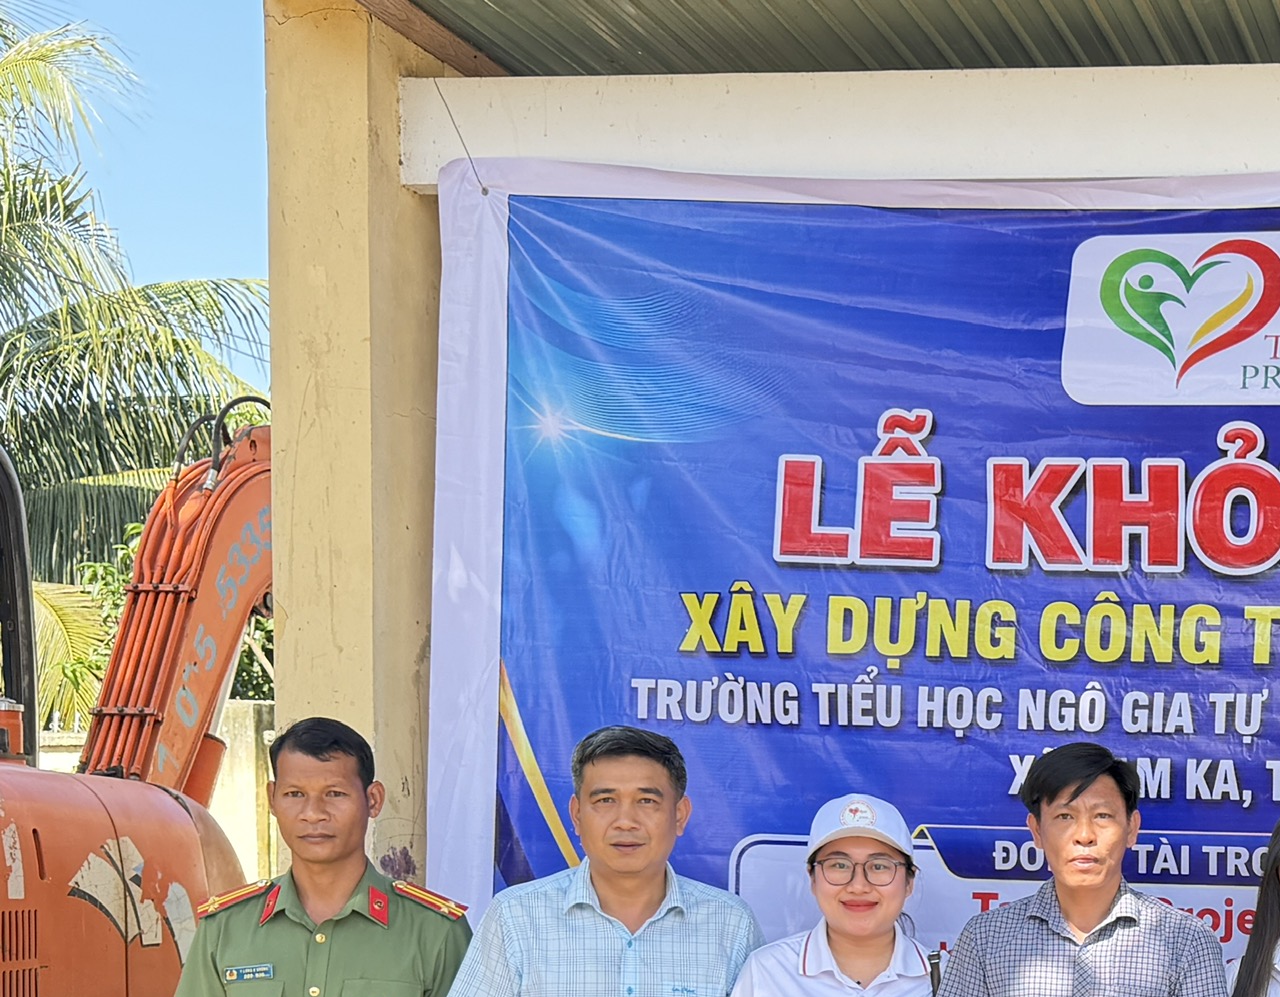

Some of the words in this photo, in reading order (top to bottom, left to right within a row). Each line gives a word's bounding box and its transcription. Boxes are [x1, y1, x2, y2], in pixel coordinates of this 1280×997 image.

[773, 408, 943, 568] LỄ
[679, 581, 806, 655] XÂY
[826, 591, 1014, 674] DỰNG
[1039, 591, 1219, 664] CÔNG
[631, 672, 799, 725] TRƯỜNG
[811, 665, 901, 726] TIỂU
[917, 686, 1002, 737] HỌC
[1017, 681, 1106, 732] NGÔ
[1121, 691, 1195, 733] GIA
[1209, 688, 1268, 743] TỰ
[1186, 759, 1252, 808] KA,
[1131, 837, 1190, 875] TÀI
